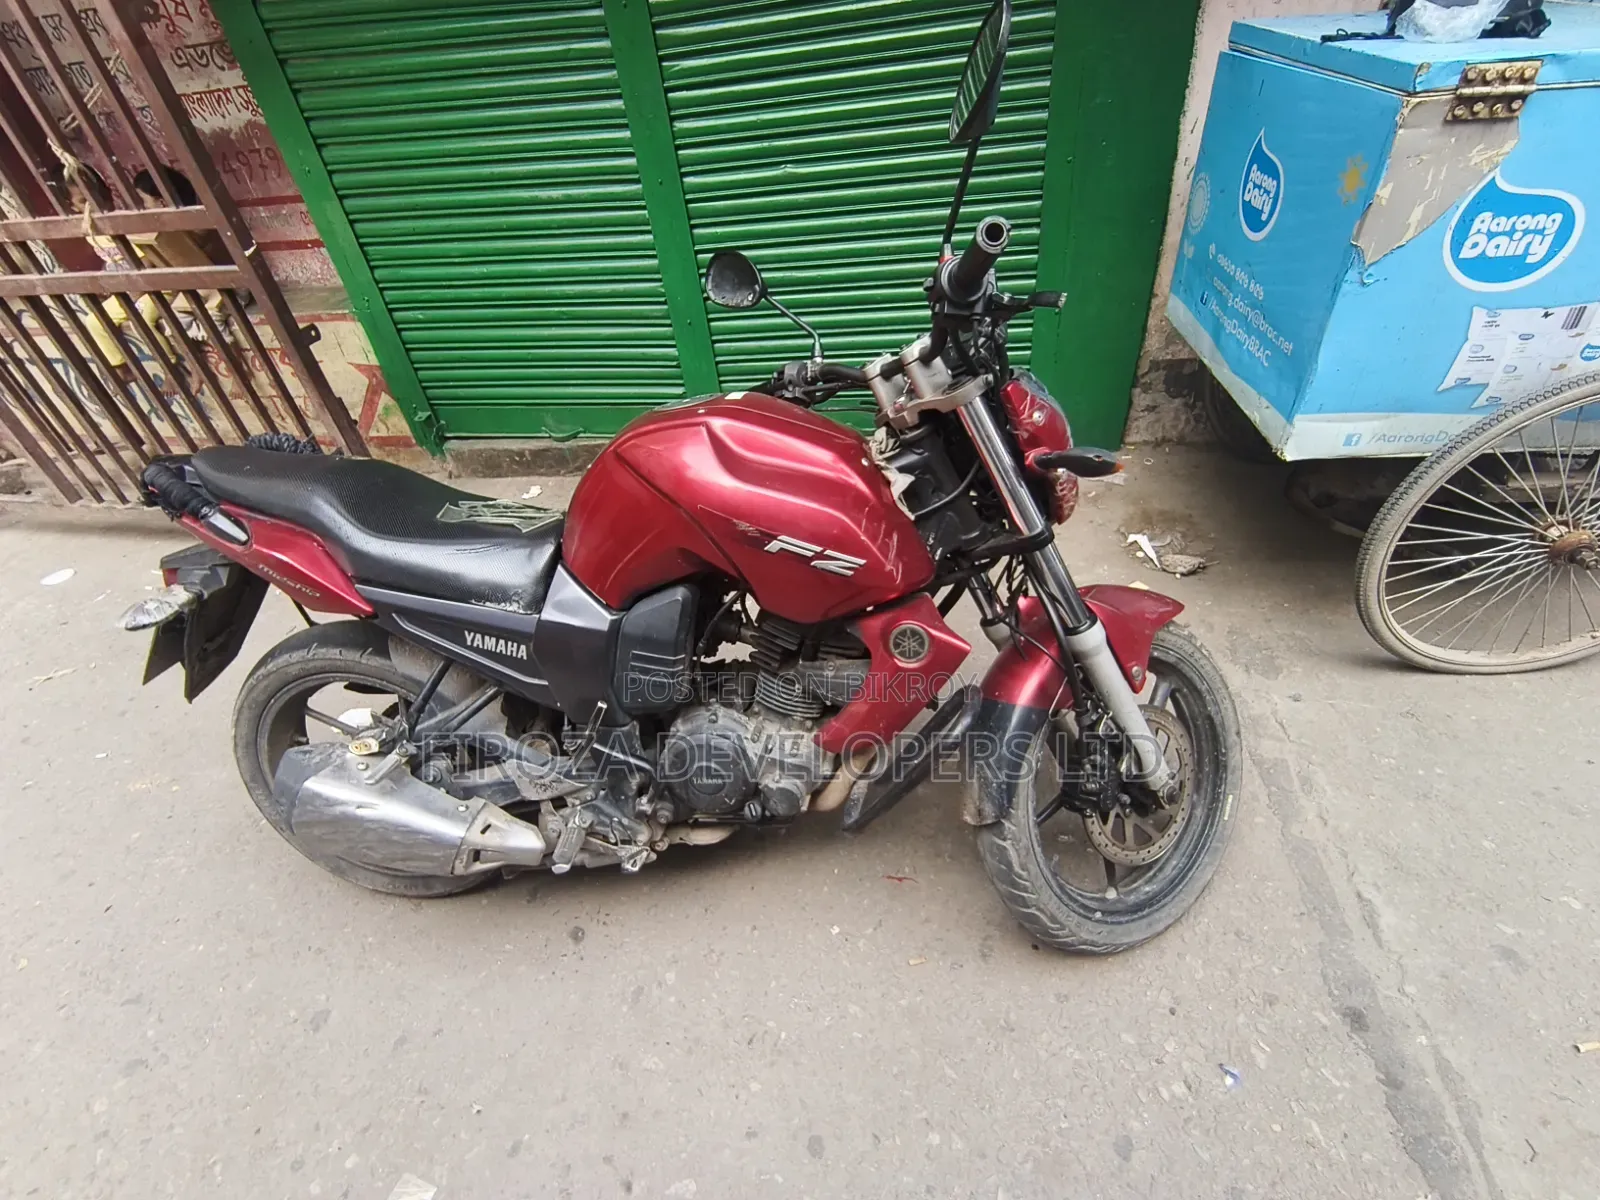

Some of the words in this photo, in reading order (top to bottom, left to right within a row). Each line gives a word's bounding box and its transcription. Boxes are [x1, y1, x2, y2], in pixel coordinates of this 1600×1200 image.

[180, 88, 241, 123] াংলাদেশ
[1249, 163, 1277, 198] Aarong
[1243, 181, 1273, 221] Dairy
[1467, 211, 1564, 238] Aarong
[1458, 231, 1556, 264] Dairy
[764, 535, 867, 577] FZ
[464, 630, 527, 660] YAMAHA
